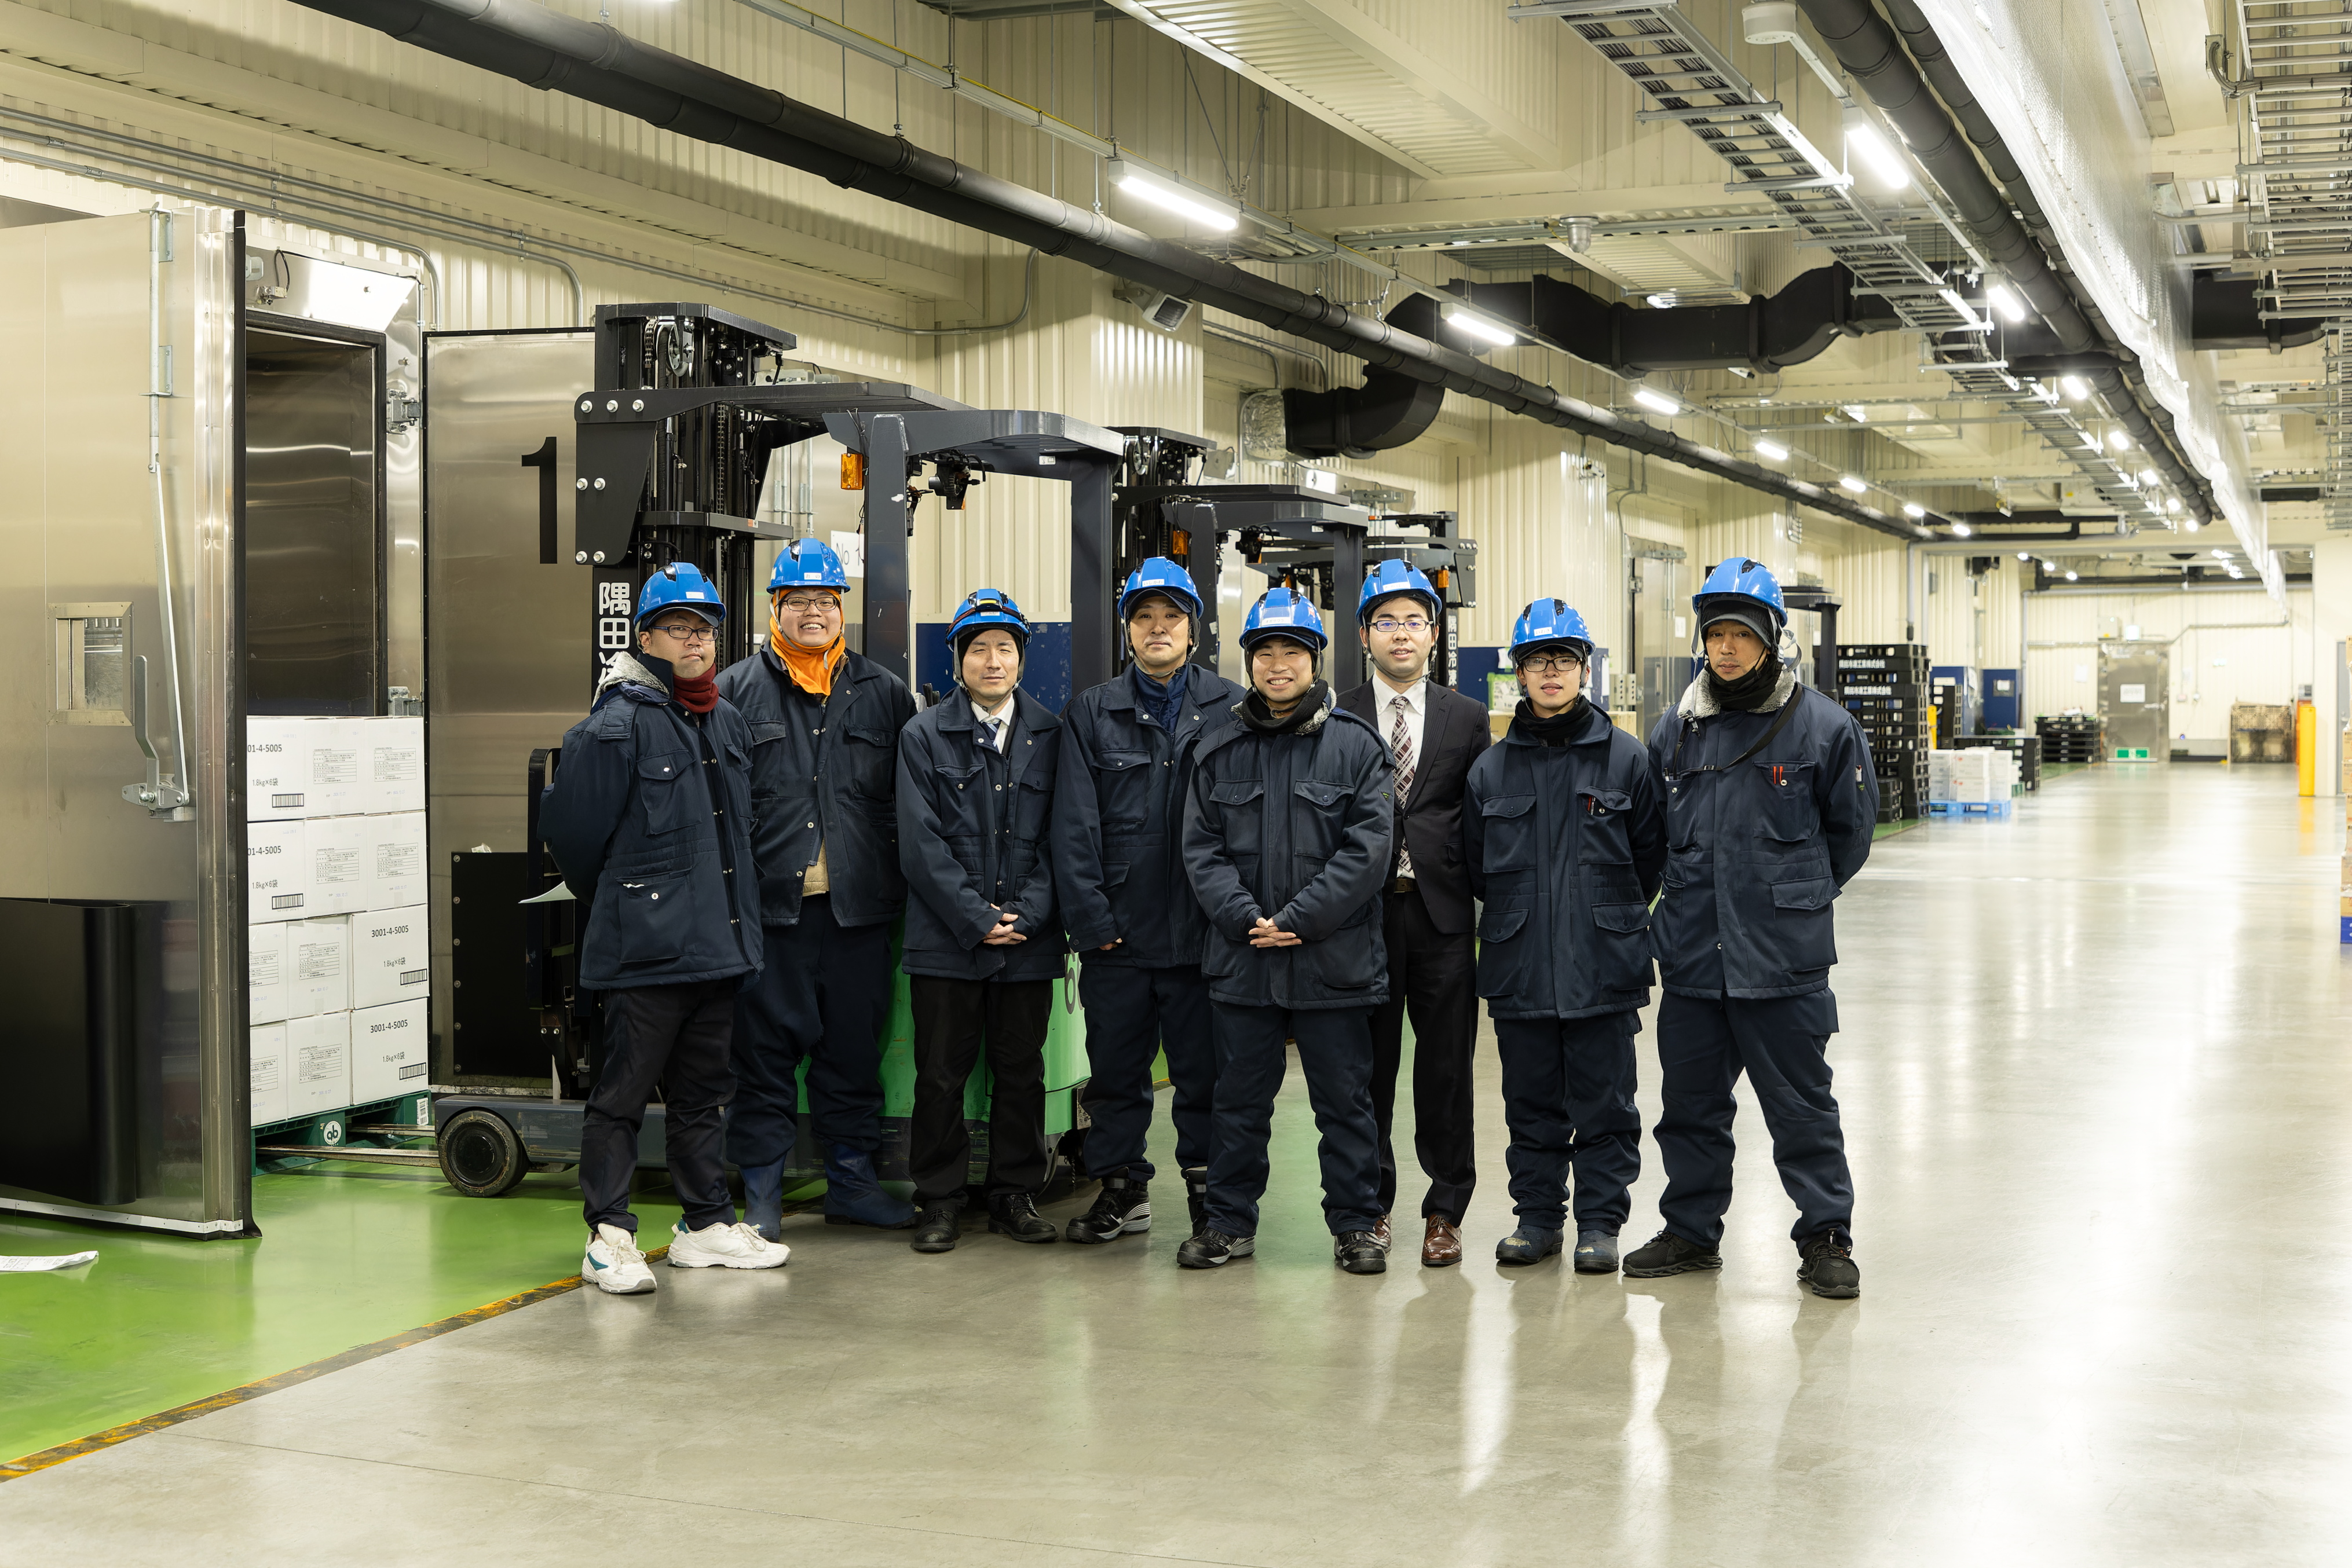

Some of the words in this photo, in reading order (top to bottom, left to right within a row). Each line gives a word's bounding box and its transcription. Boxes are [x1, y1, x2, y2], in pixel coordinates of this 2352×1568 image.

[521, 436, 558, 565] 1
[836, 542, 850, 565] No
[1448, 615, 1457, 686] 隅田冷凍
[247, 744, 282, 753] 01-4-5005
[247, 845, 281, 856] 01-4-5005
[371, 925, 409, 937] 3001-4-5005
[370, 1019, 408, 1033] 3001-4-5005
